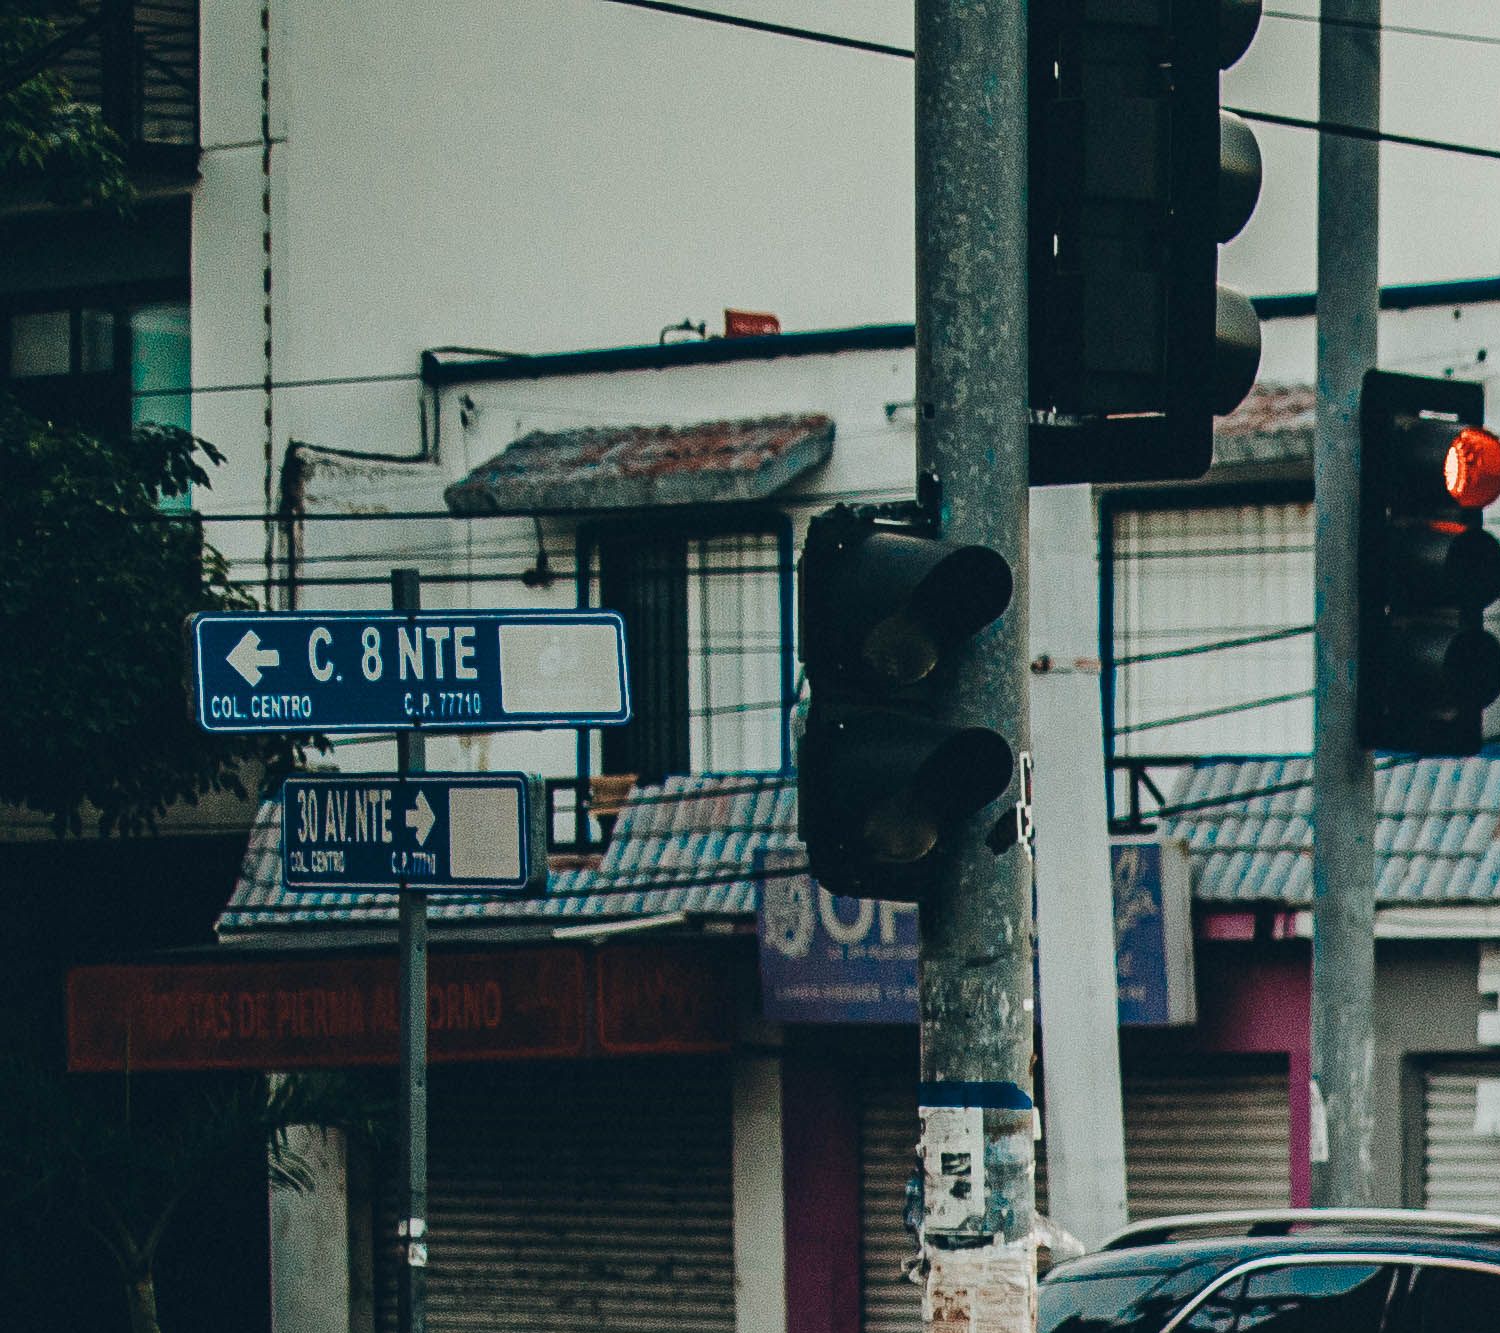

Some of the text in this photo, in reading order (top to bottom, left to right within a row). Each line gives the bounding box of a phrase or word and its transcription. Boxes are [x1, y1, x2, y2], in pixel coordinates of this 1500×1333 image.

[308, 626, 478, 682] C. 8 NTE
[210, 695, 312, 718] COL. CENTRO
[439, 692, 482, 716] 77710
[297, 789, 318, 843] 30
[426, 978, 503, 1030] ORNO
